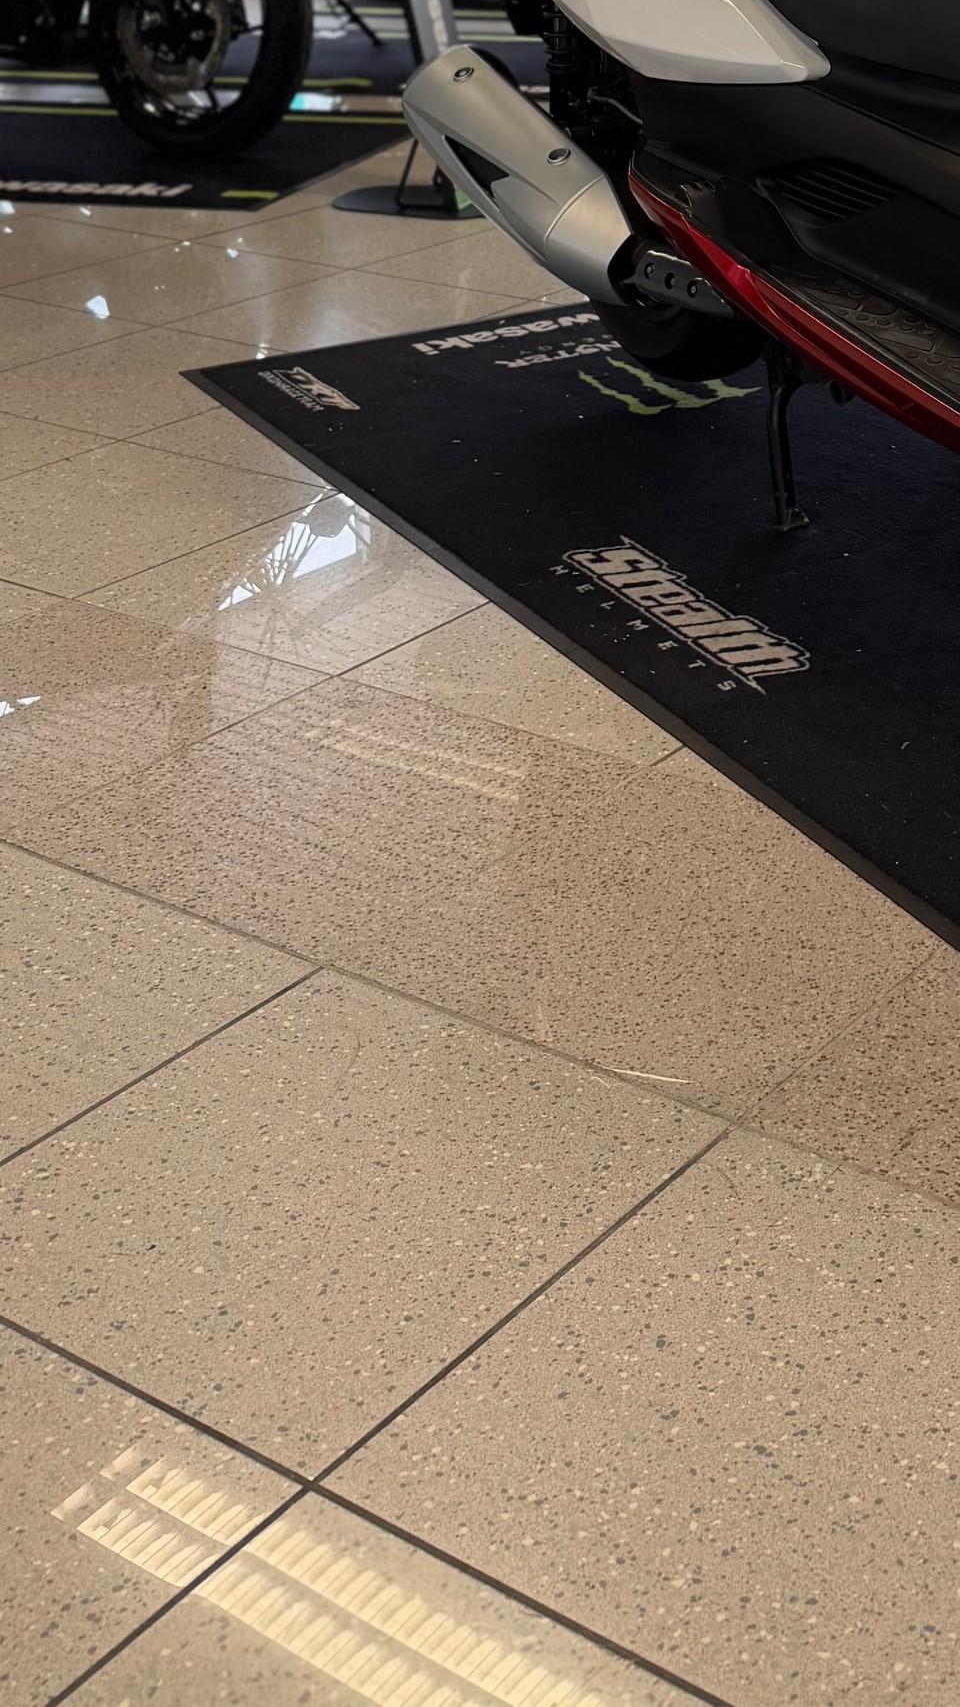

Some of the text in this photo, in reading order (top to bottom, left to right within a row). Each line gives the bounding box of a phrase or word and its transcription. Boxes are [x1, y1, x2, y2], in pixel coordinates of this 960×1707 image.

[412, 312, 600, 355] wasaki
[495, 340, 622, 369] NSTER
[550, 564, 736, 692] HELMETS
